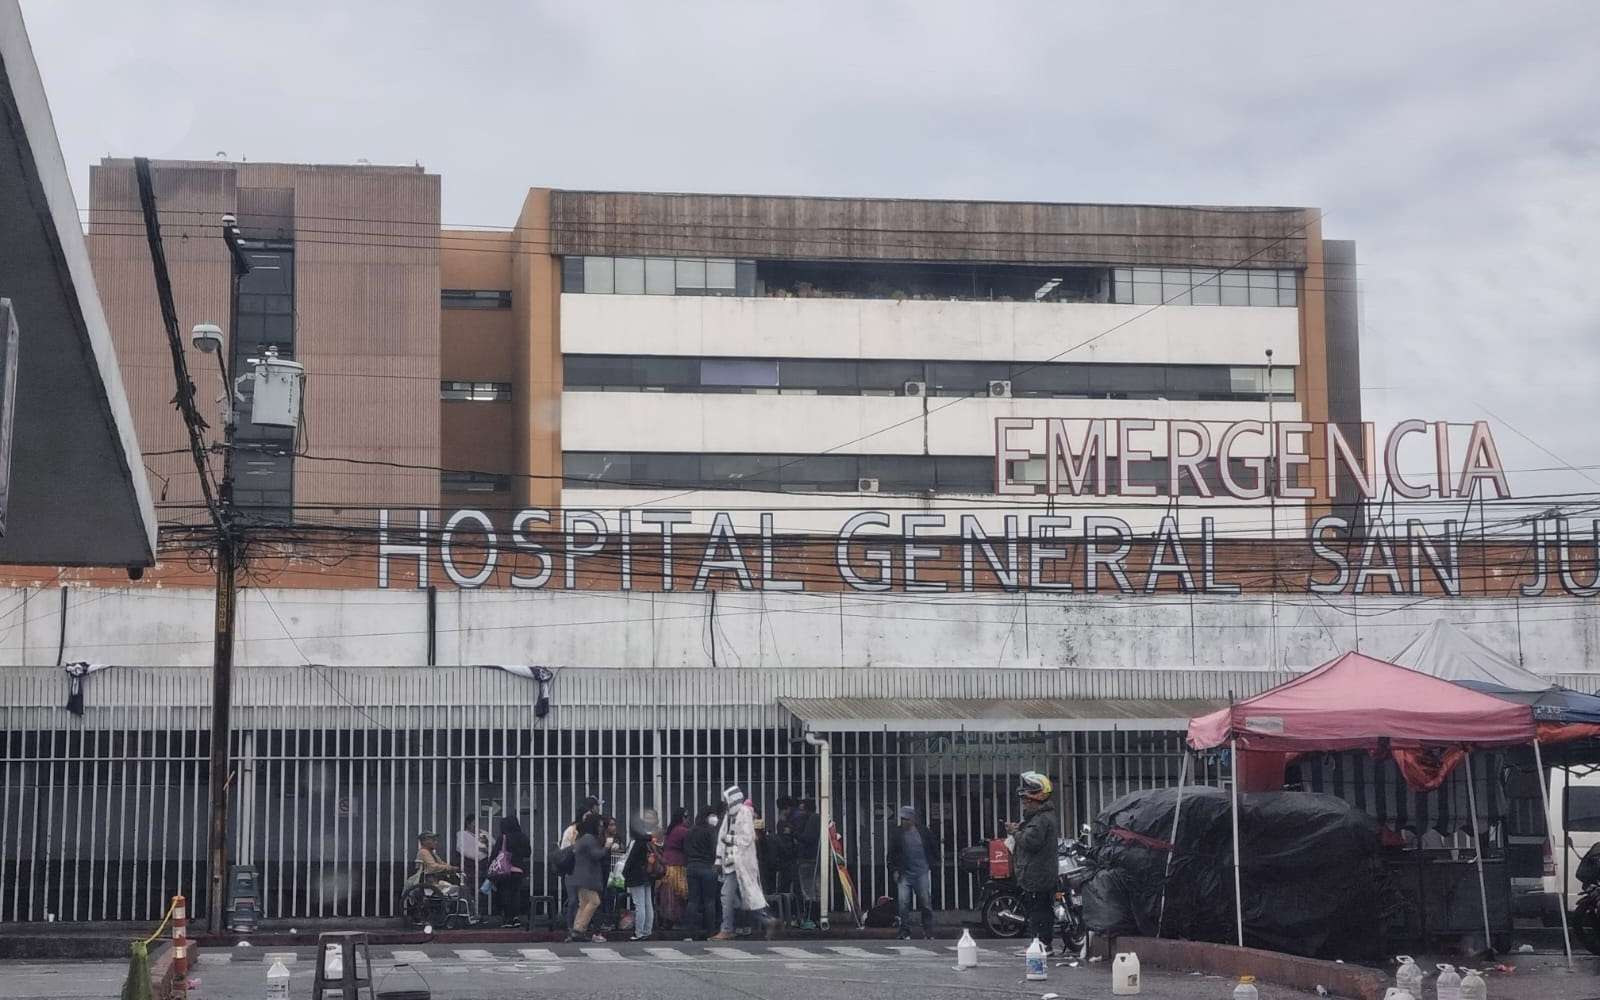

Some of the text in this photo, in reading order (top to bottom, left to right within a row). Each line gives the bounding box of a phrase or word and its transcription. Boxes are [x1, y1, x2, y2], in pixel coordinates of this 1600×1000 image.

[994, 417, 1511, 499] EMERGENCIA
[378, 508, 805, 591] HOSPITAL
[836, 511, 1242, 594] GENERAL
[1308, 515, 1462, 597] SAN
